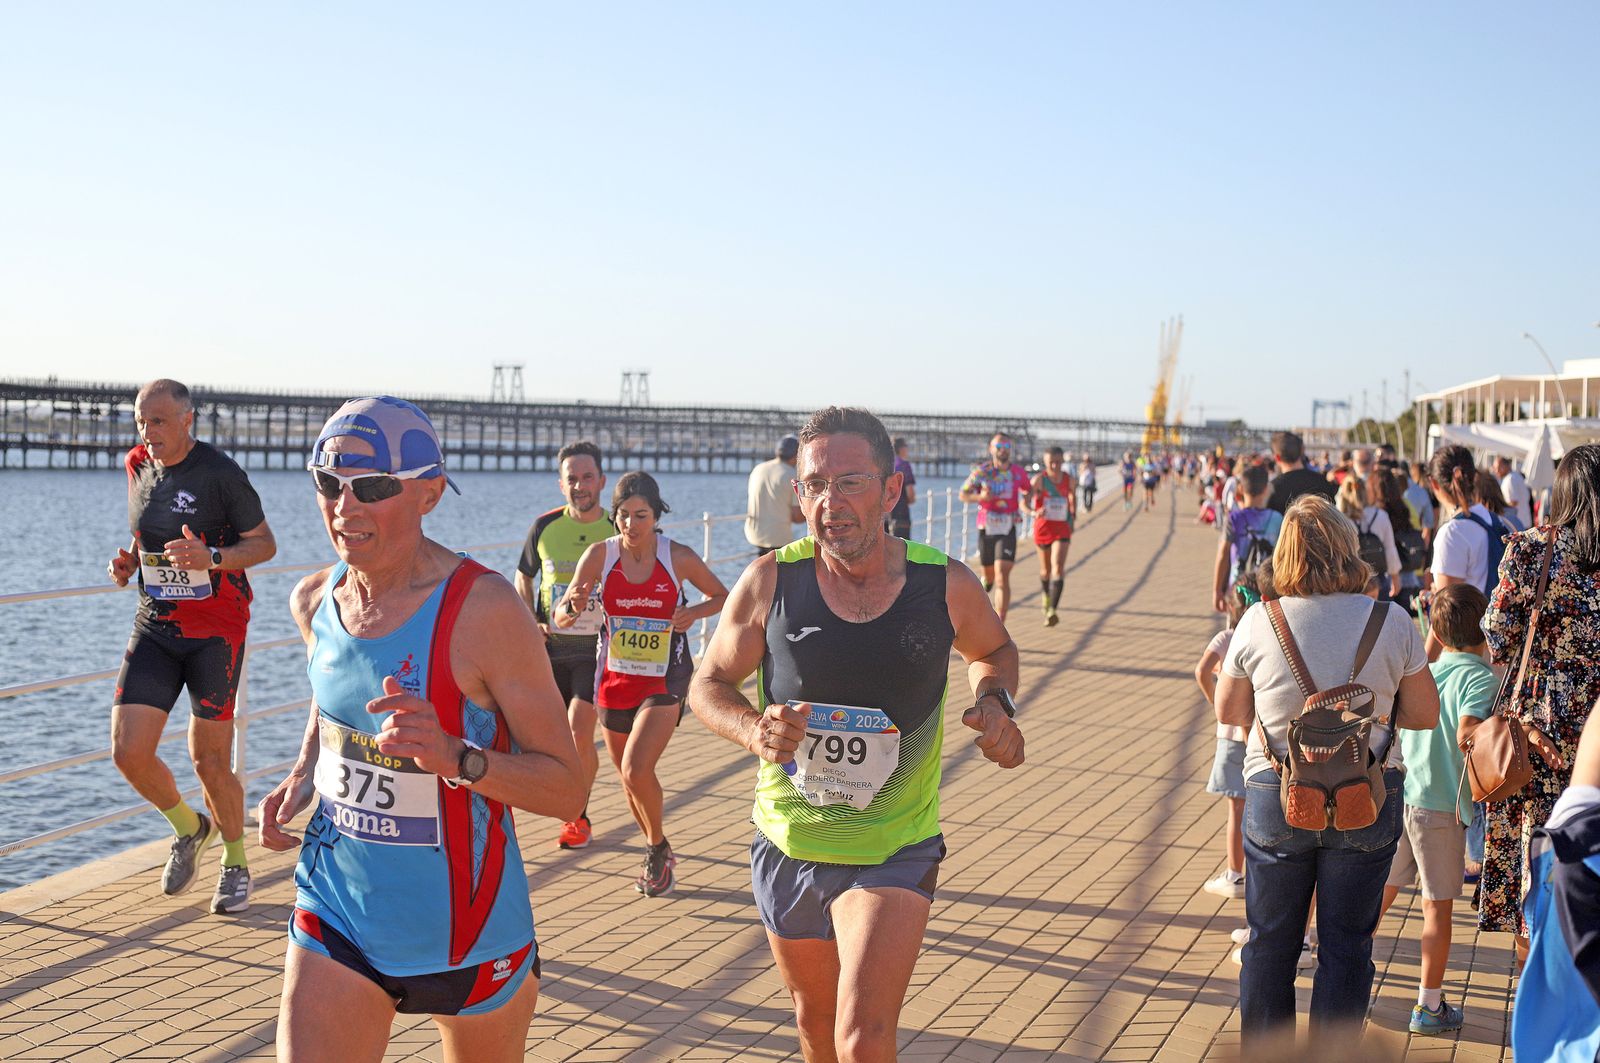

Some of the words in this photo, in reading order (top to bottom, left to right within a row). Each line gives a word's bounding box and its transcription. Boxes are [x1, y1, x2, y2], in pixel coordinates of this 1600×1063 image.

[157, 569, 190, 585] 328
[619, 631, 660, 650] 1408
[855, 714, 889, 729] 2023
[805, 731, 867, 766] 799
[365, 751, 402, 769] LOOP
[822, 766, 847, 778] DIEGO
[336, 763, 395, 810] 375
[836, 777, 873, 789] BARRERA
